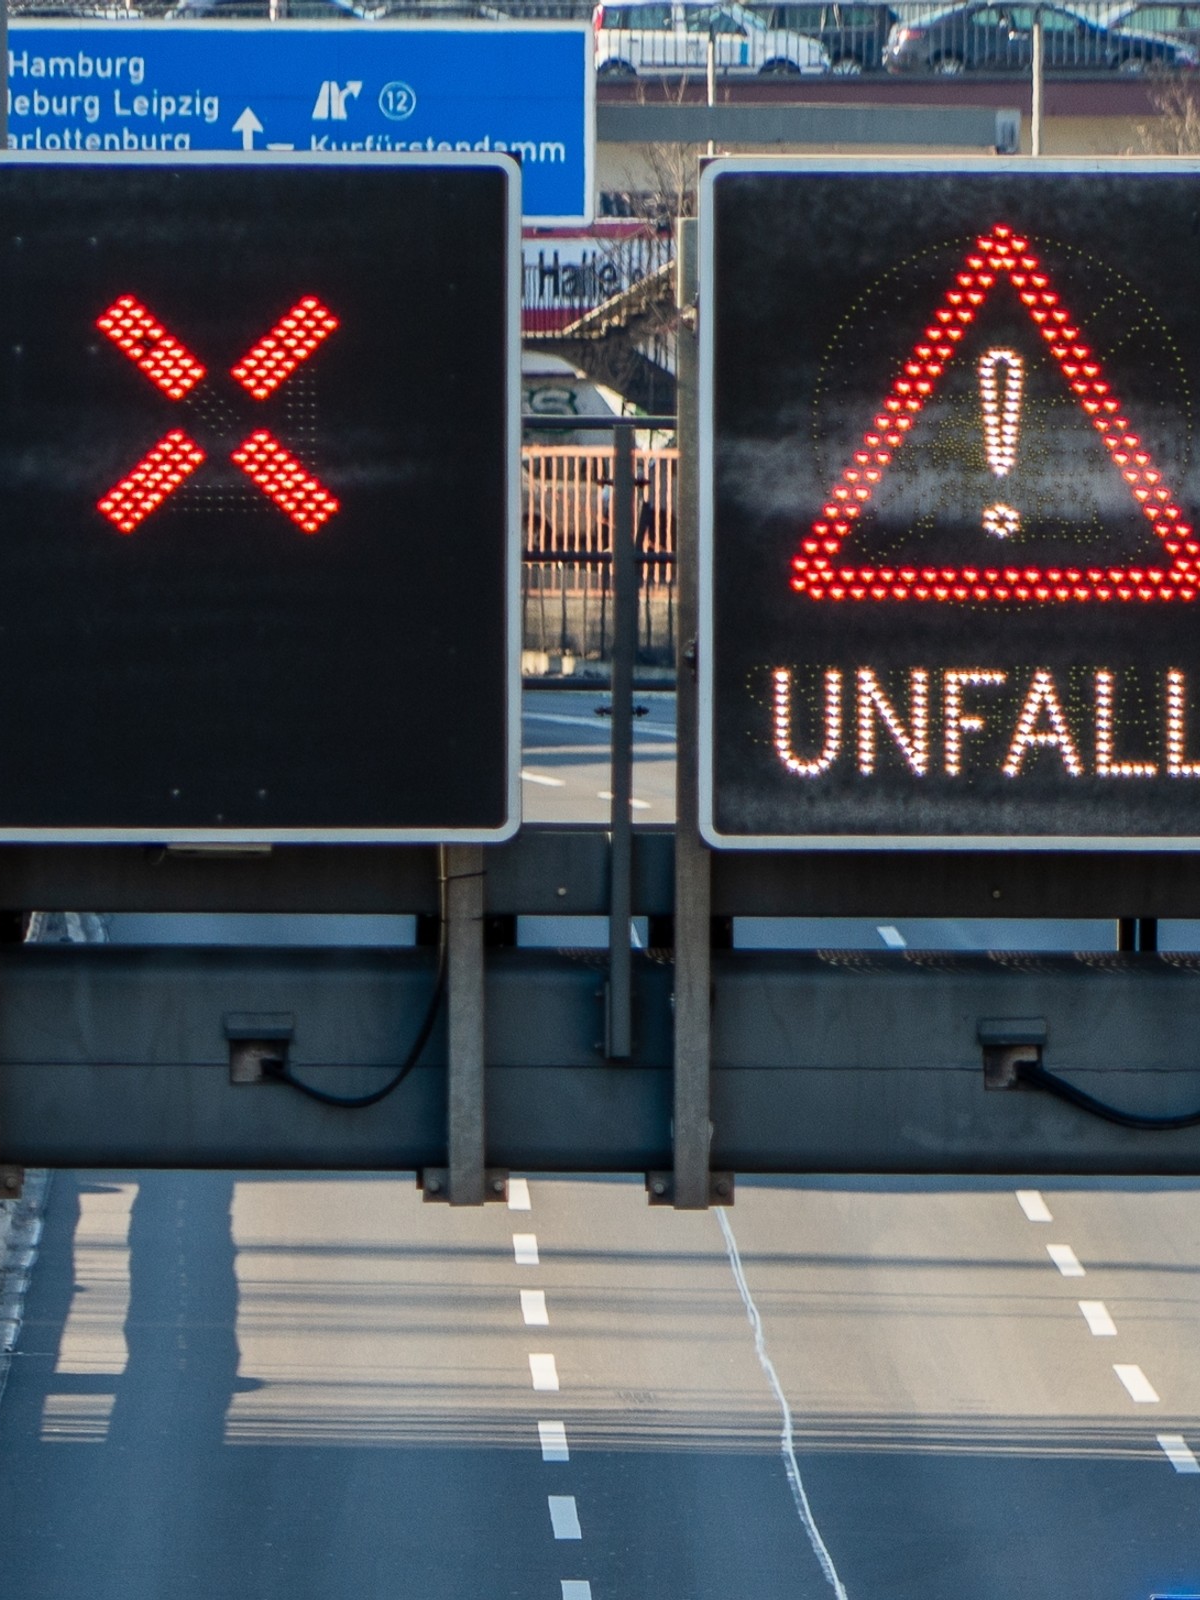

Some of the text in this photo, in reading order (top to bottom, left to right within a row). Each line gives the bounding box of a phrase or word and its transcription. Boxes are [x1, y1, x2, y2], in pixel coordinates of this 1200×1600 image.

[8, 50, 145, 85] Hamburg
[113, 88, 220, 123] Leipzig
[386, 89, 409, 112] 12
[771, 665, 1200, 777] UNFALL
